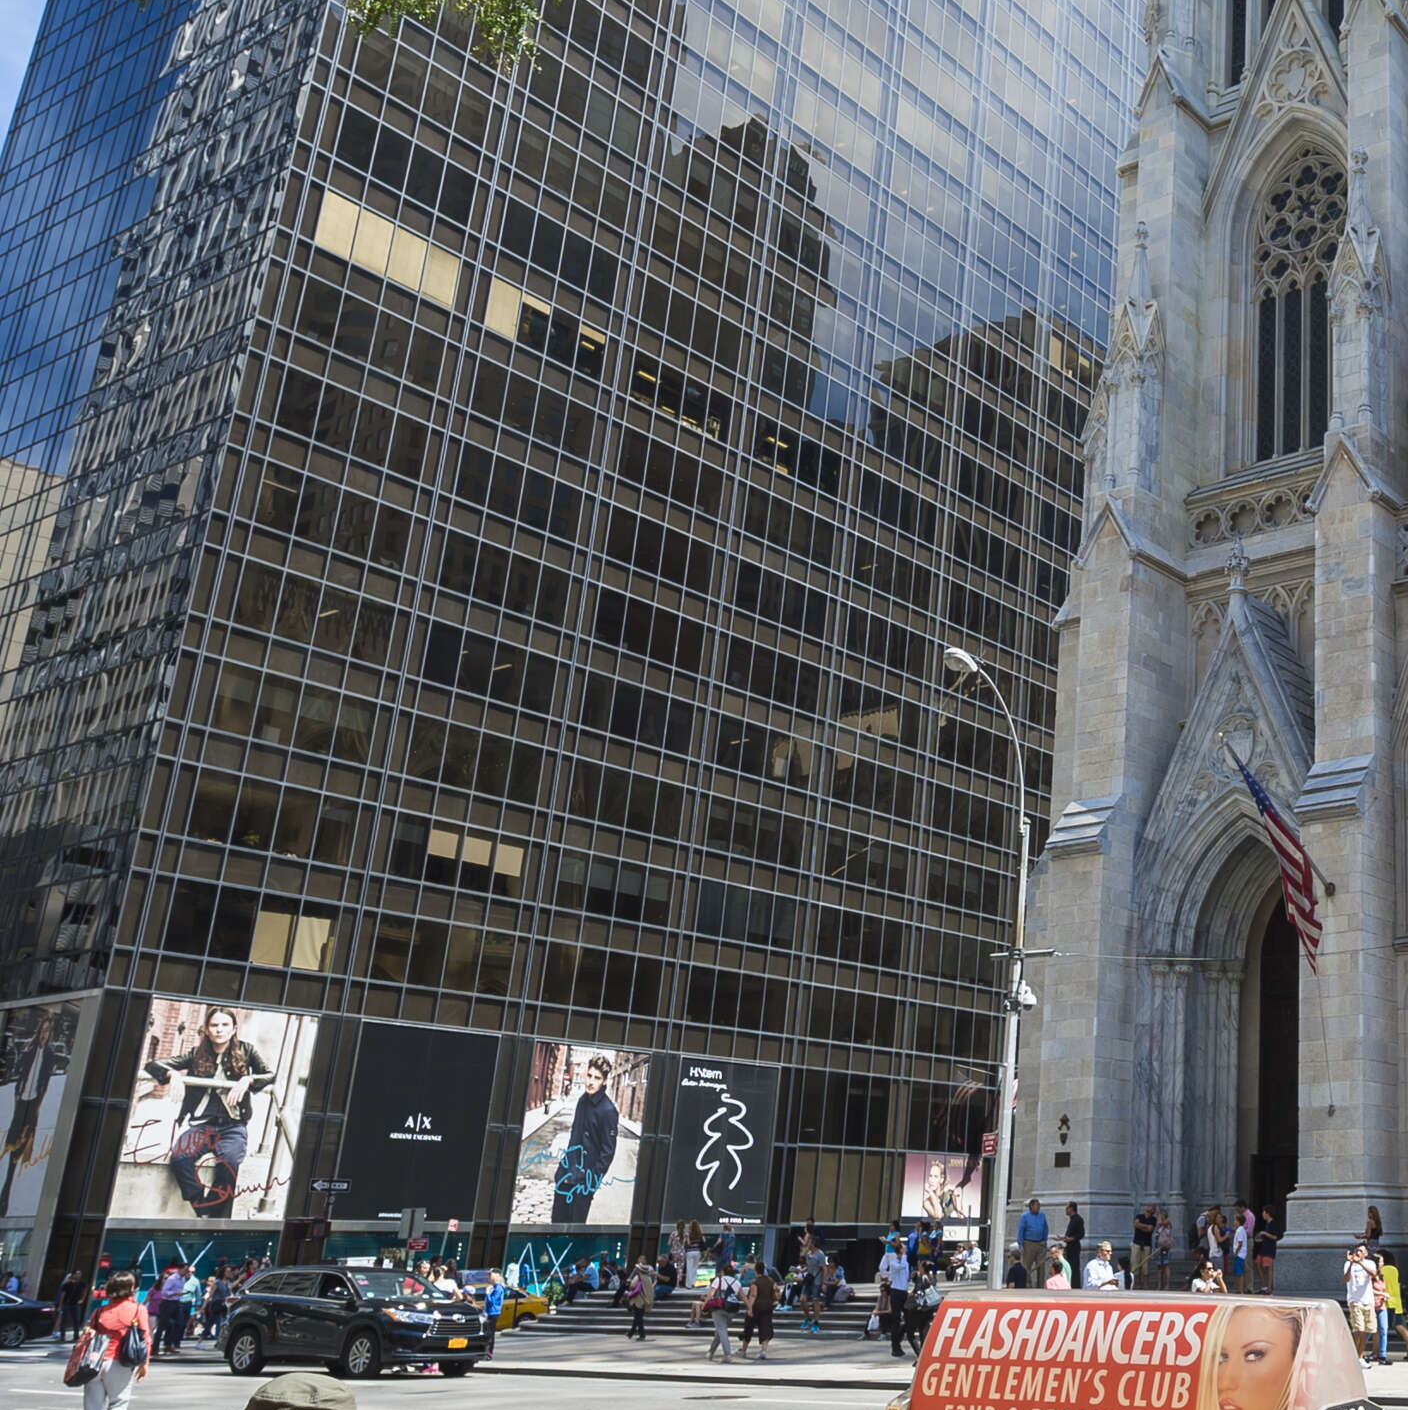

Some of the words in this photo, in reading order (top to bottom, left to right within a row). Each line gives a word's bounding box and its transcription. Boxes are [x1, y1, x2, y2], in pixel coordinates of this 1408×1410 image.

[931, 1308, 1209, 1367] FLASHDANCERS
[921, 1362, 1109, 1406] GENTLEMEN'S
[1116, 1370, 1192, 1409] CLUB
